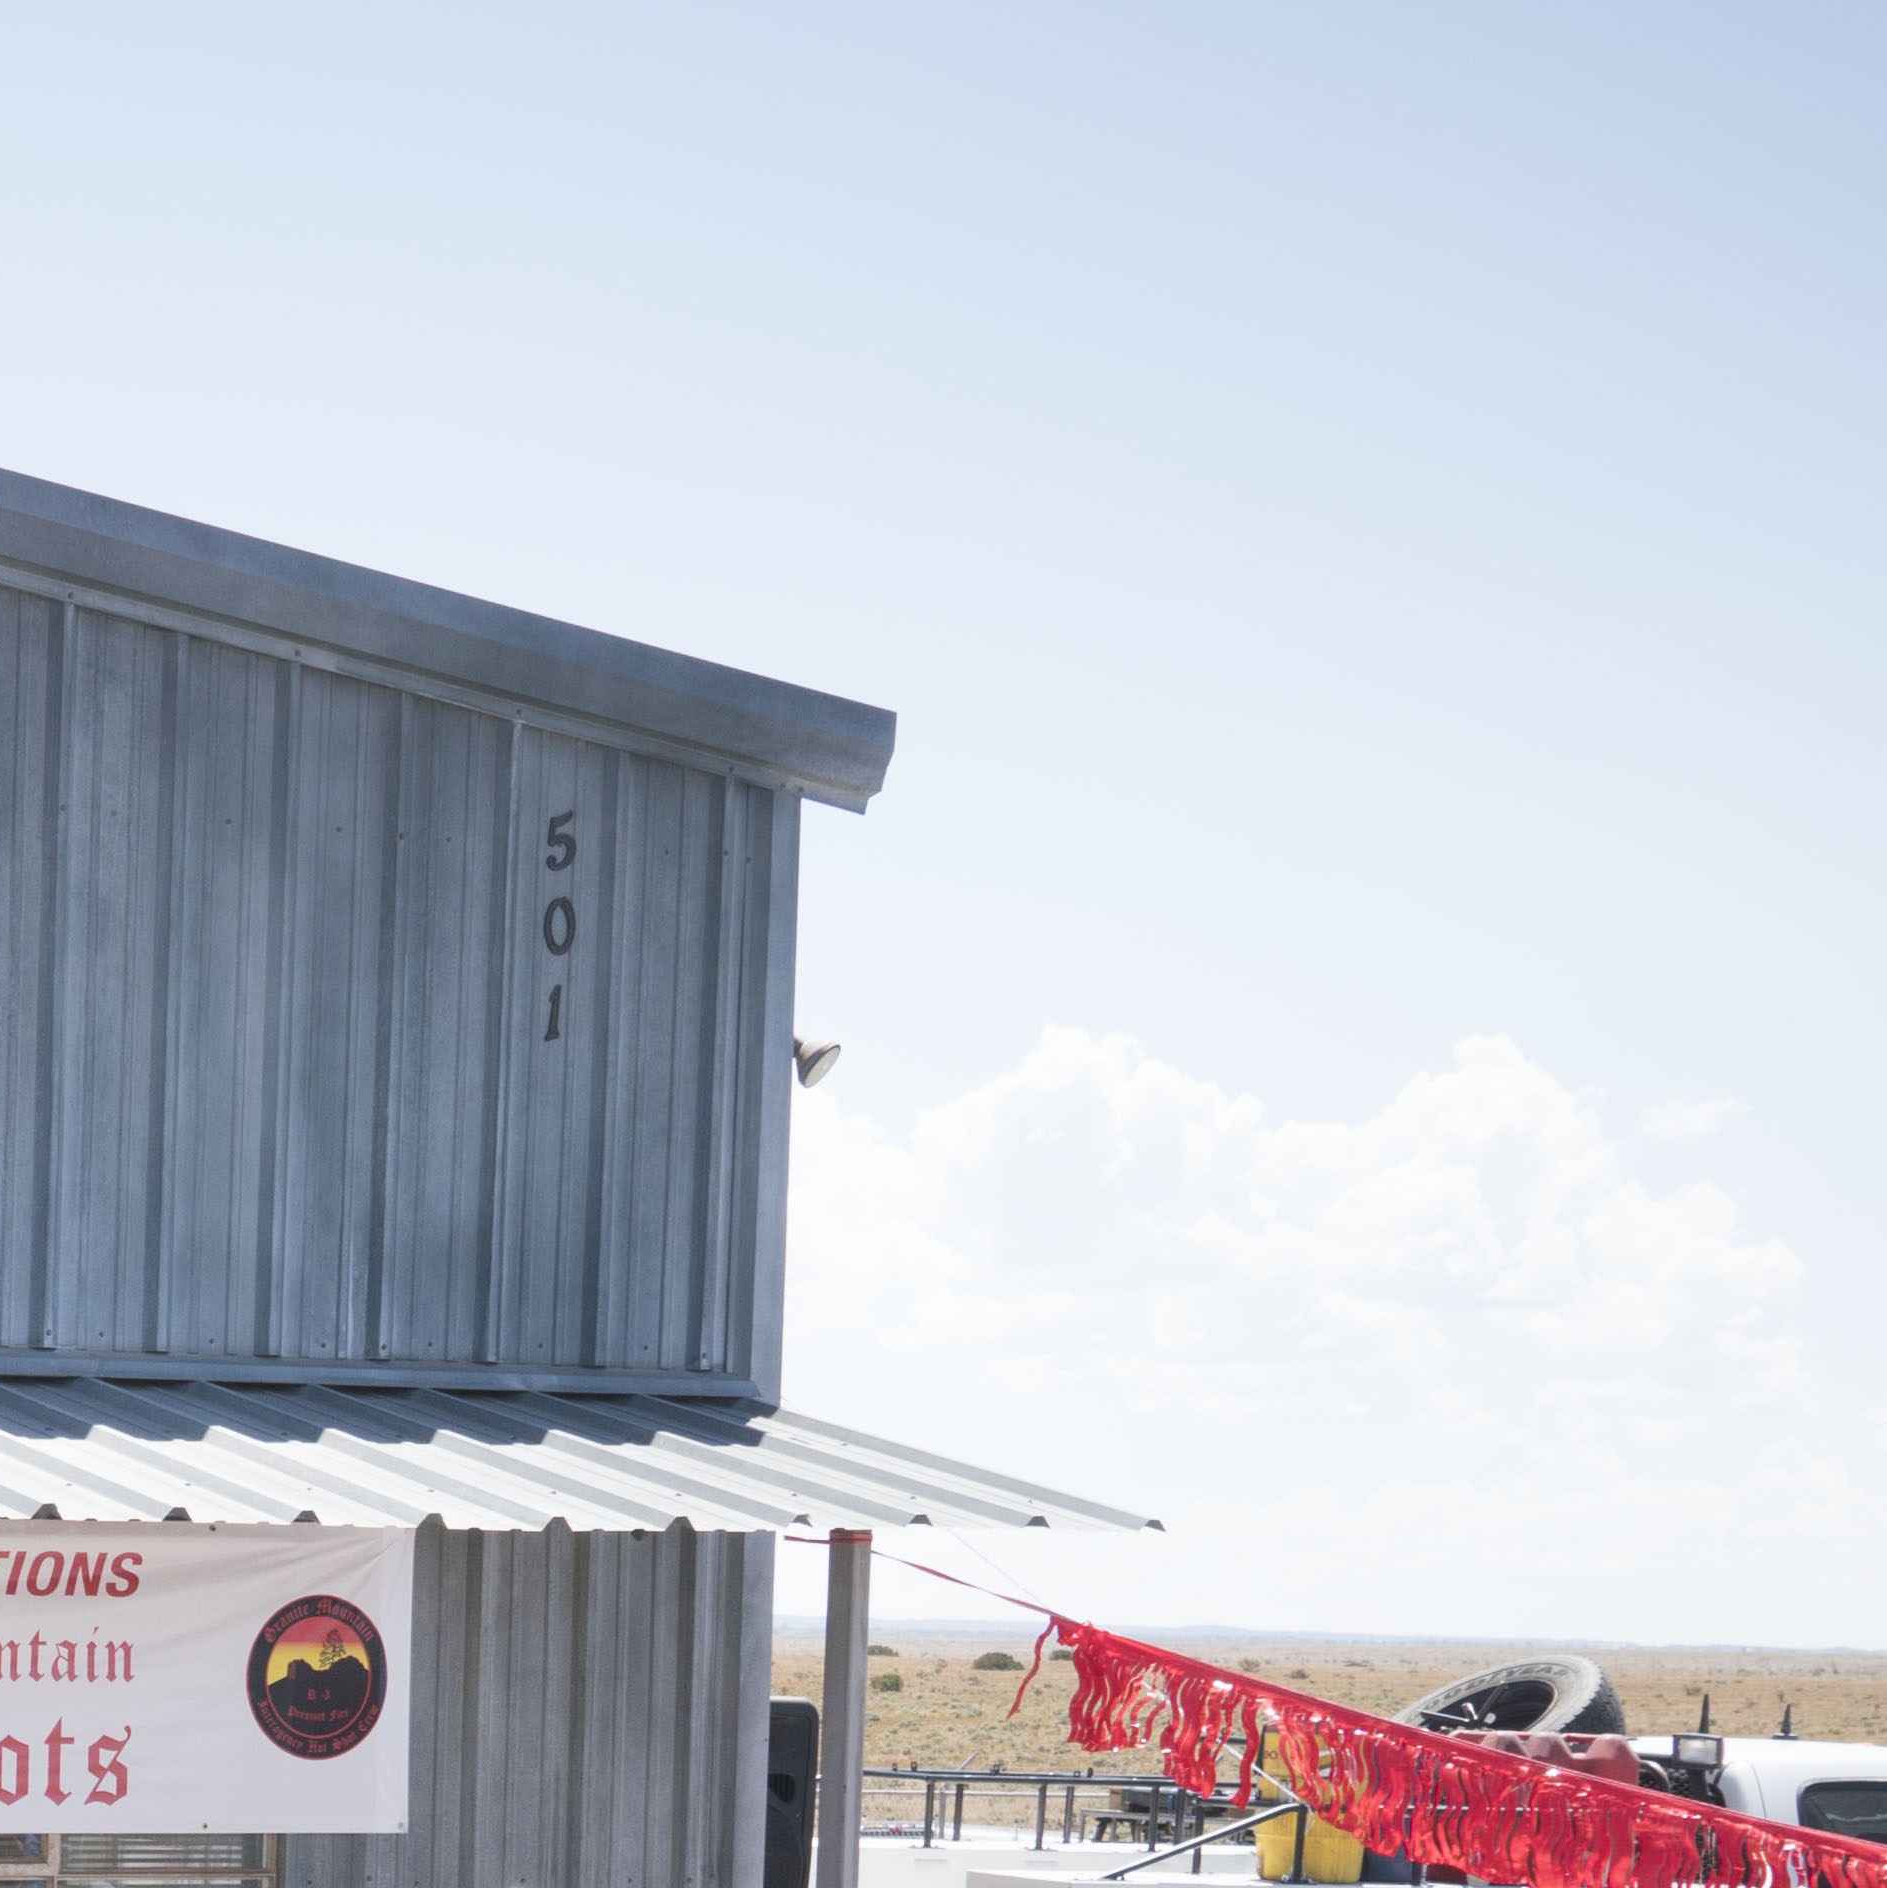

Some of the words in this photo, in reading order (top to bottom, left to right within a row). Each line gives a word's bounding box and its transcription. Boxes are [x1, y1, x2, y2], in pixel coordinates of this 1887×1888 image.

[543, 809, 577, 1042] 501
[264, 1604, 310, 1643] Granite
[314, 1598, 373, 1642] Mountain
